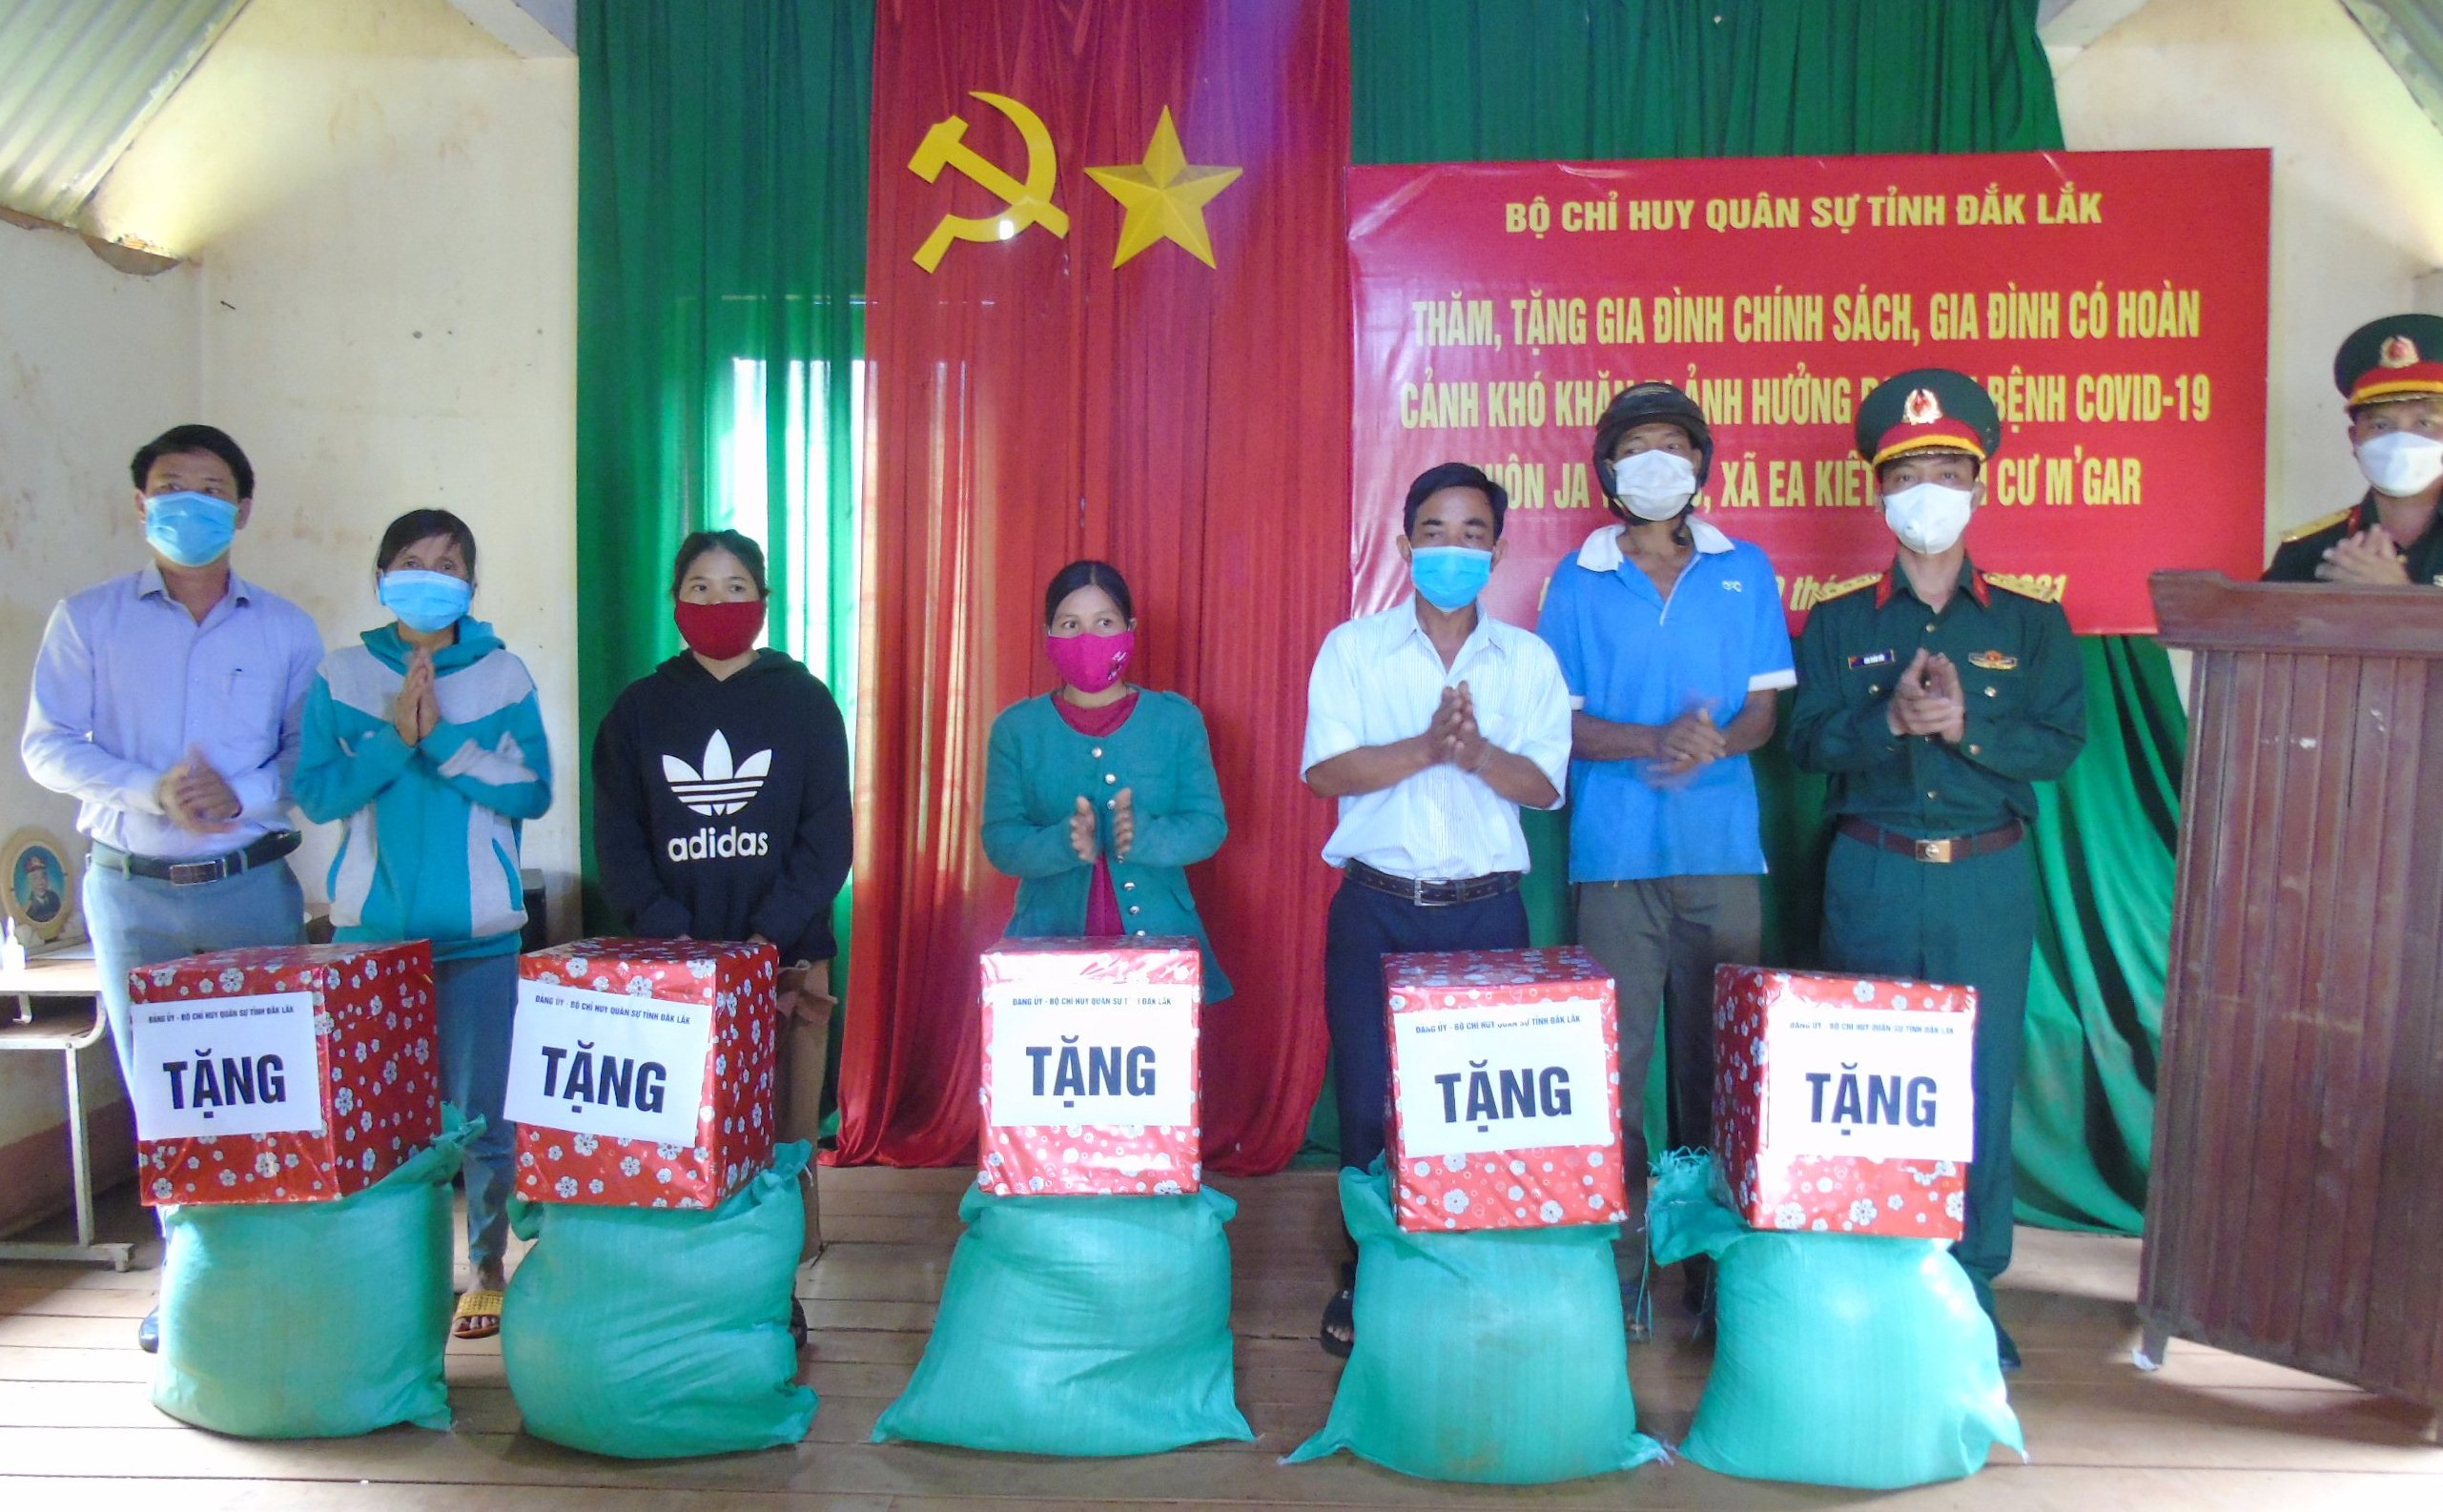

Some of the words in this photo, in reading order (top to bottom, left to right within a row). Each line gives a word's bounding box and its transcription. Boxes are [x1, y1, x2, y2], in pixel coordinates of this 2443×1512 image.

[1506, 195, 1550, 239] BỘ
[1561, 191, 1618, 233] CHỈ
[1629, 199, 1694, 231] HUY
[1705, 192, 1800, 234] QUÂN
[1811, 194, 1860, 235] SỰ
[1867, 186, 1945, 227] TỈNH
[1956, 182, 2025, 226] ĐẮK
[2038, 181, 2103, 224] LẮK
[1411, 290, 1502, 353] THĂM,
[1510, 289, 1587, 356] TẶNG
[1596, 296, 1645, 346] GIA
[1653, 287, 1724, 344] ĐÌNH
[1733, 285, 1823, 343] CHÍNH
[1833, 284, 1920, 347] SÁCH,
[1930, 293, 1979, 342] GIA
[1987, 281, 2060, 340] ĐÌNH
[2068, 280, 2108, 339] CÓ
[2118, 279, 2200, 338] HOÀN
[1400, 368, 1479, 429] CẢNH
[1488, 372, 1547, 427] KHÓ
[1752, 361, 1852, 426] HƯỞNG
[2076, 373, 2210, 423] COVID-19
[1553, 463, 1591, 509] JA
[1720, 452, 1760, 508] XÃ
[1770, 460, 1807, 508] EA
[1997, 455, 2040, 508] CƯ
[2046, 445, 2142, 506] M'GAR
[668, 826, 769, 862] adidas
[162, 1048, 286, 1119] TẶNG
[542, 1039, 667, 1114] TẶNG
[1026, 1034, 1156, 1108] TẶNG
[1434, 1059, 1572, 1133] TẶNG
[1805, 1062, 1938, 1136] TẶNG
